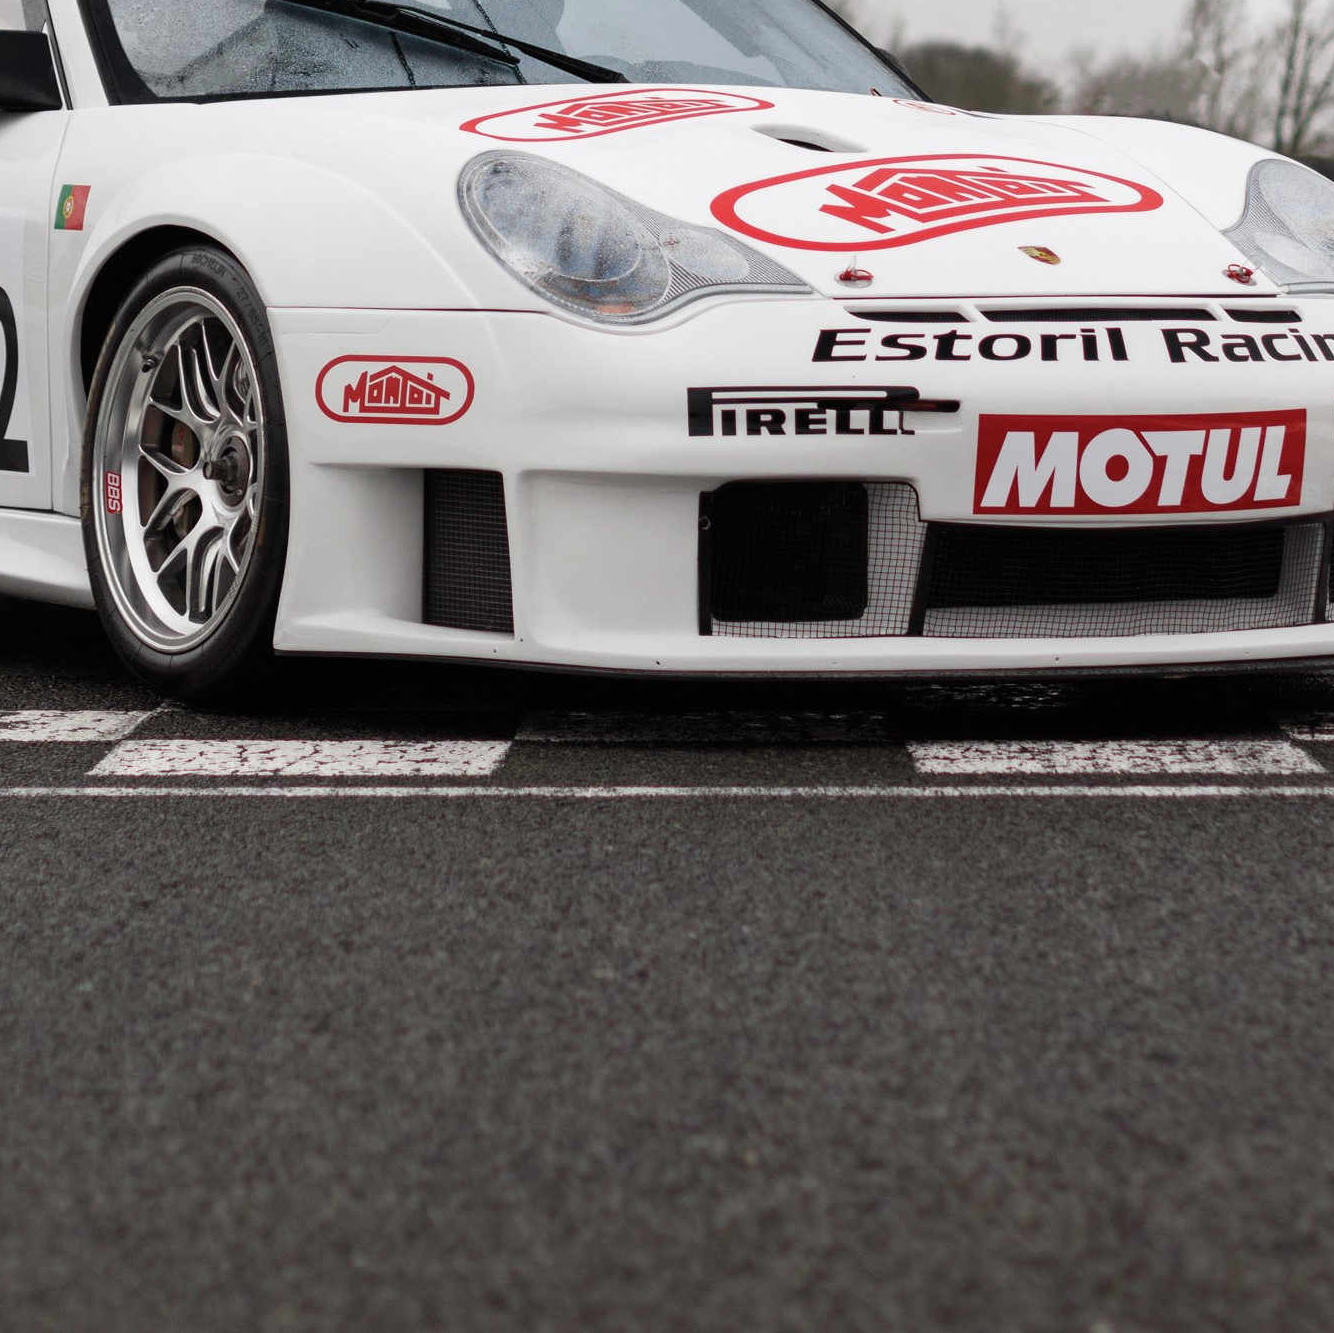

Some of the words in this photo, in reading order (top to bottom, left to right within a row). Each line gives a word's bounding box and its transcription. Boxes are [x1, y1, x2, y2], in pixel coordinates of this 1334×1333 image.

[812, 328, 1130, 363] Estoril
[980, 424, 1291, 509] MOTUL
[107, 472, 121, 512] BBS
